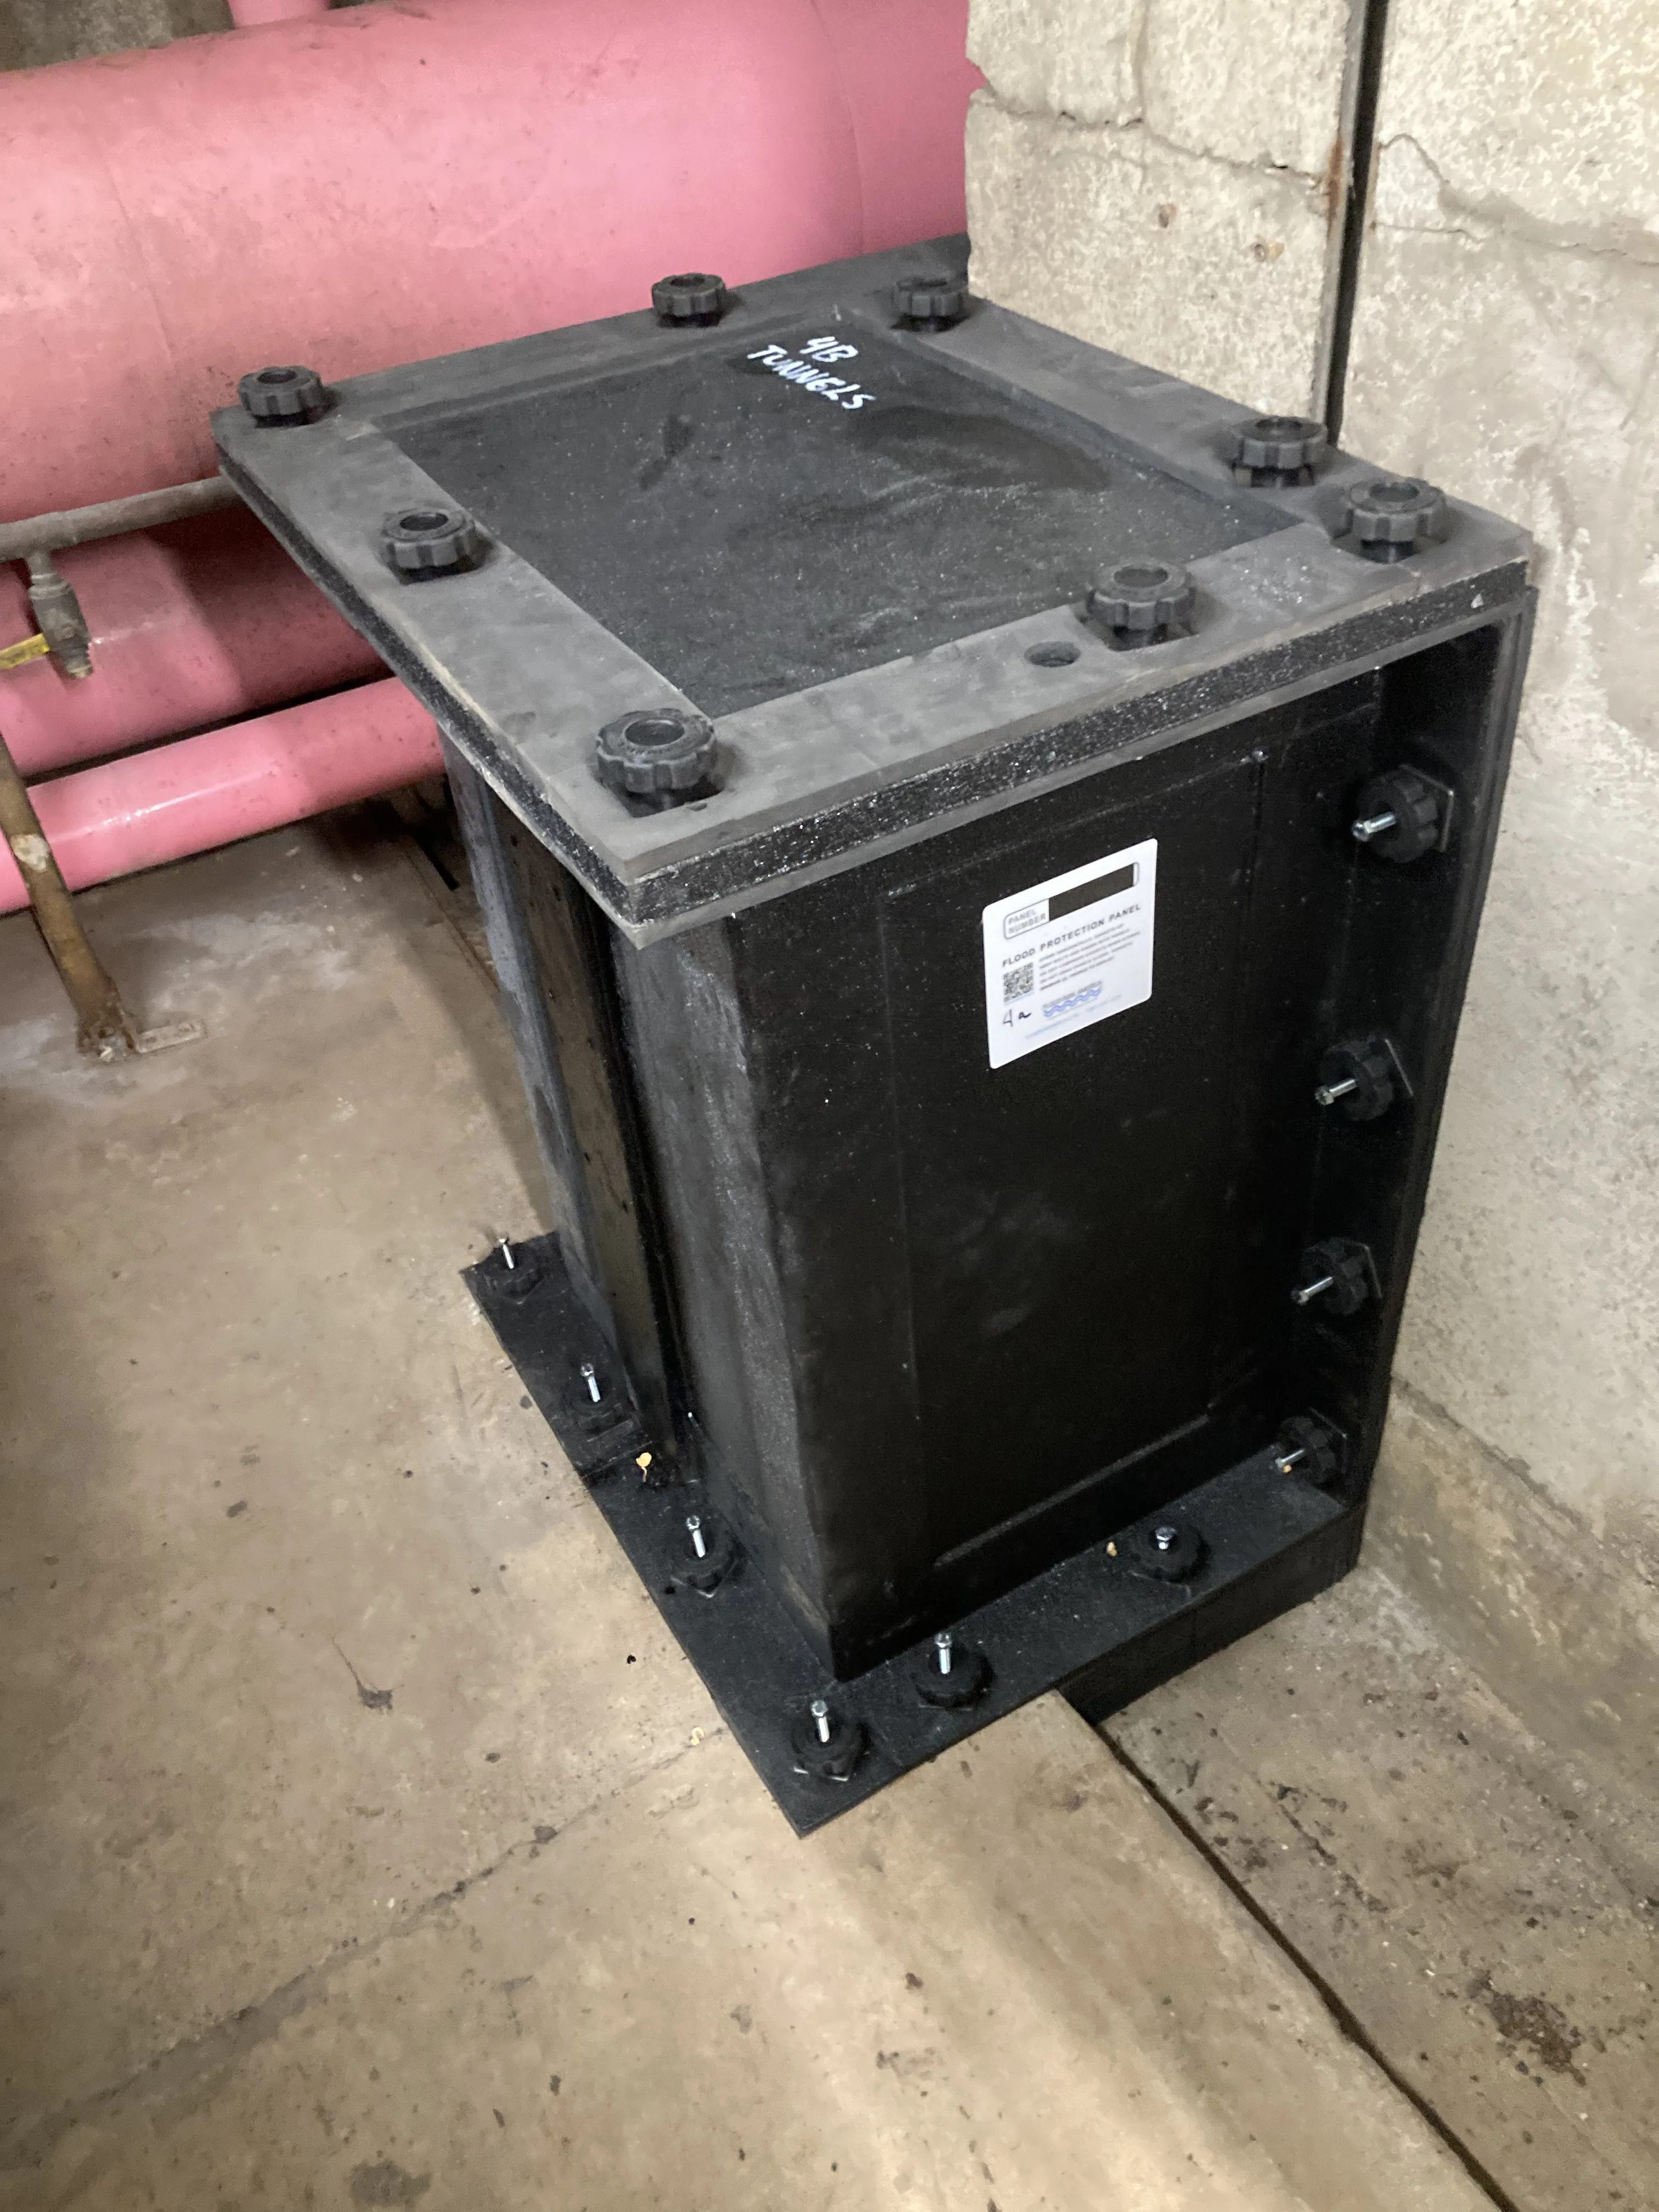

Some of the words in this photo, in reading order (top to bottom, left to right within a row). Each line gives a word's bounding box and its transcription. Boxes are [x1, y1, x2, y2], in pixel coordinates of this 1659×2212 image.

[799, 336, 859, 363] 4B
[747, 345, 877, 410] TUNNELS
[1008, 908, 1036, 925] PANEL
[1008, 912, 1046, 934] NUMBER
[1002, 948, 1035, 967] FLOOD
[1040, 918, 1105, 952] PROTECTION
[1108, 903, 1142, 922] PANEL
